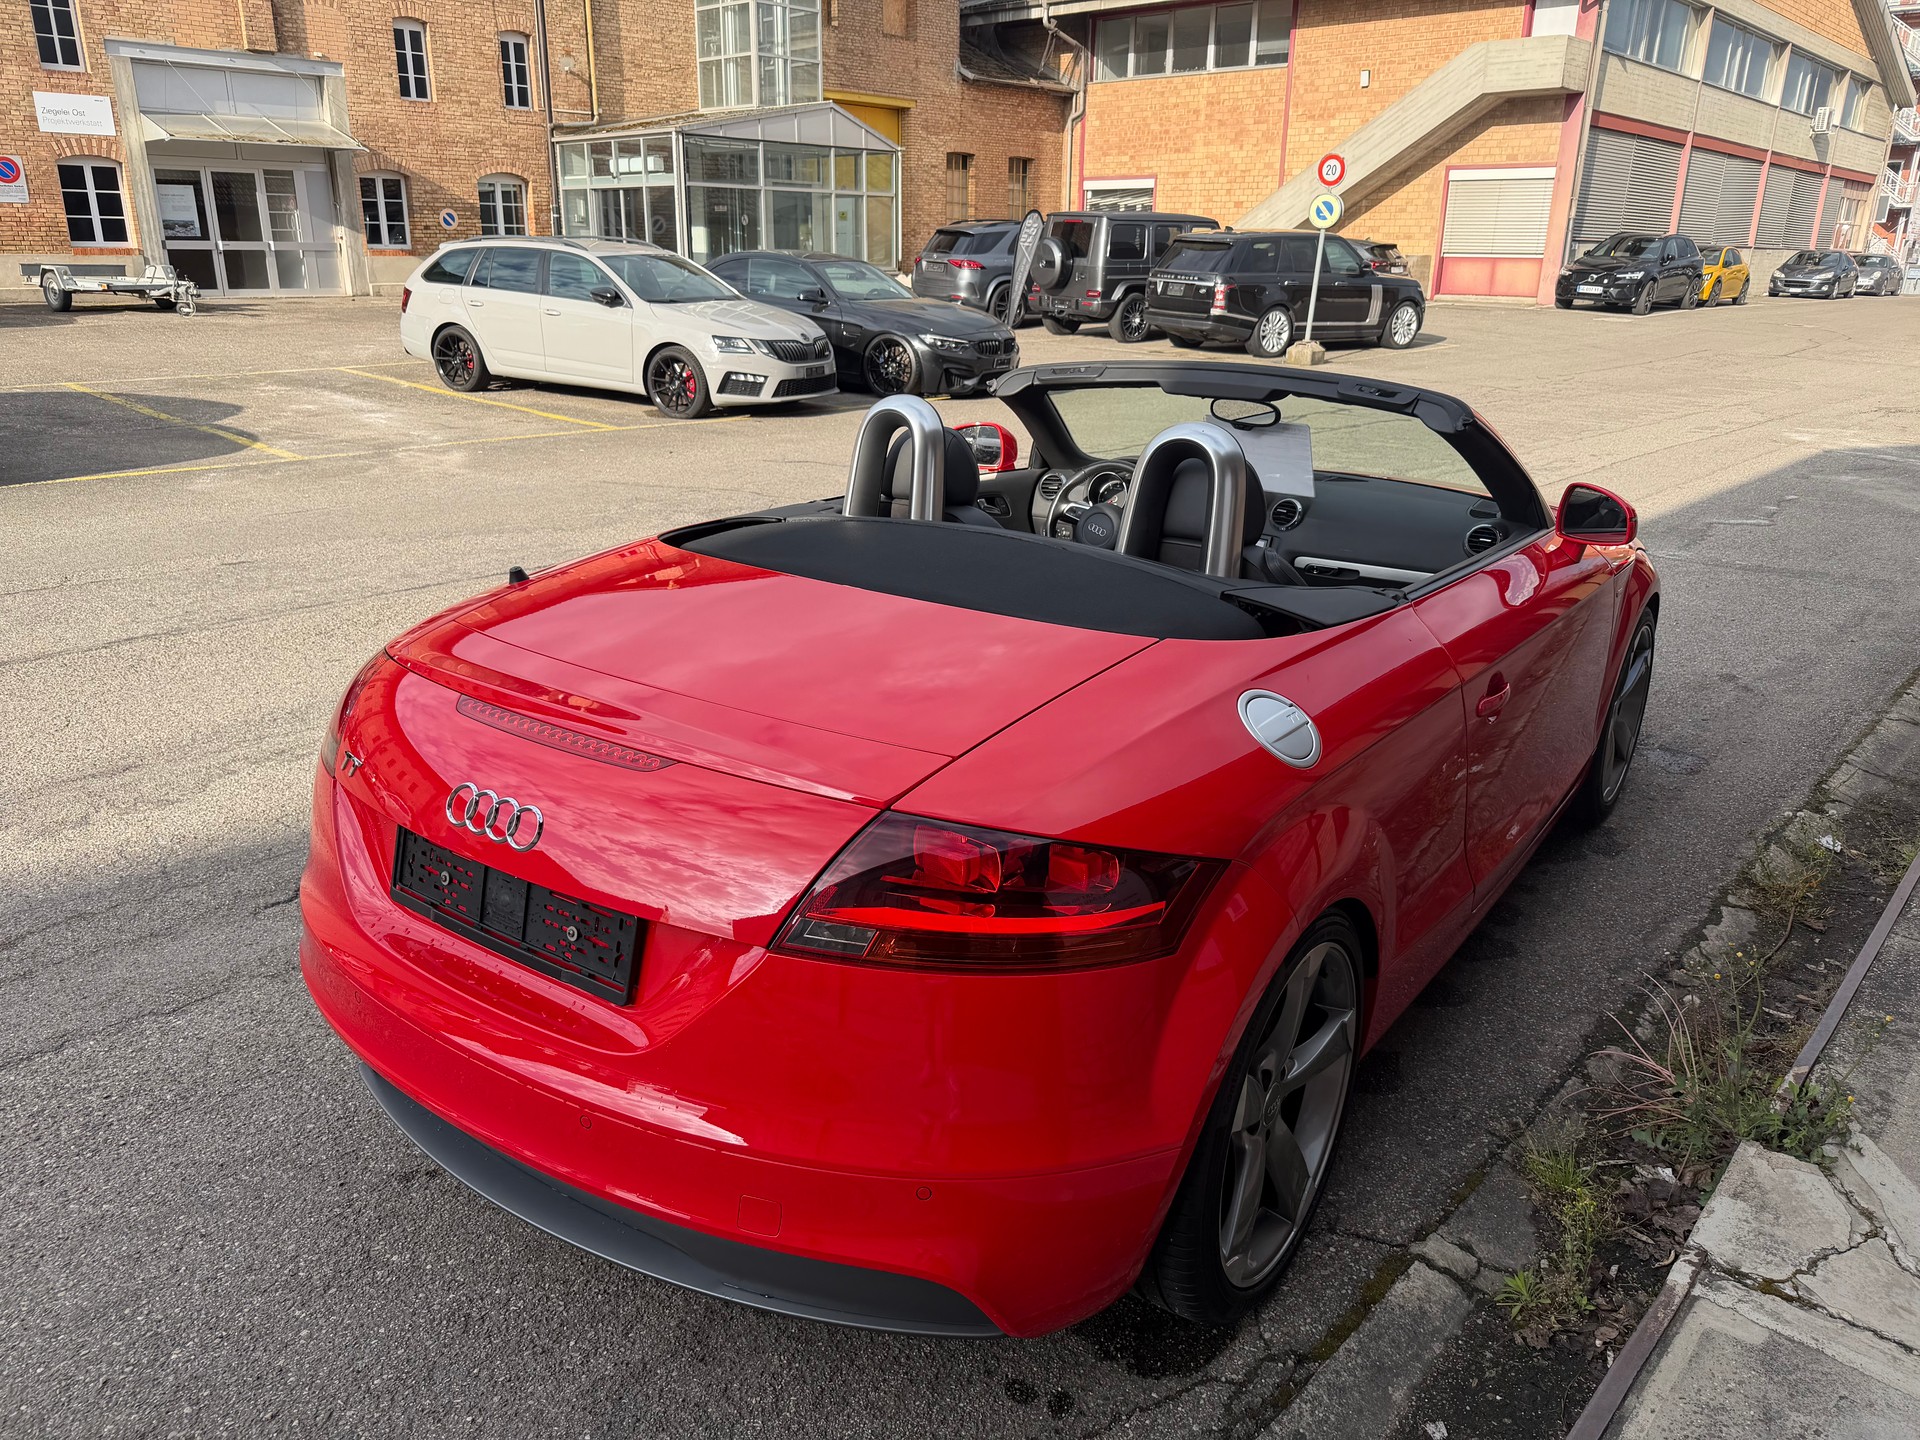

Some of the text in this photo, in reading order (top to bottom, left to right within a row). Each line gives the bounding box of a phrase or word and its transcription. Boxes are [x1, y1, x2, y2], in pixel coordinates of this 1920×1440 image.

[71, 108, 86, 117] Ost
[42, 115, 103, 127] Projektwerkstatt
[1325, 164, 1337, 175] 20
[1286, 711, 1300, 723] TT
[341, 750, 363, 777] TT
